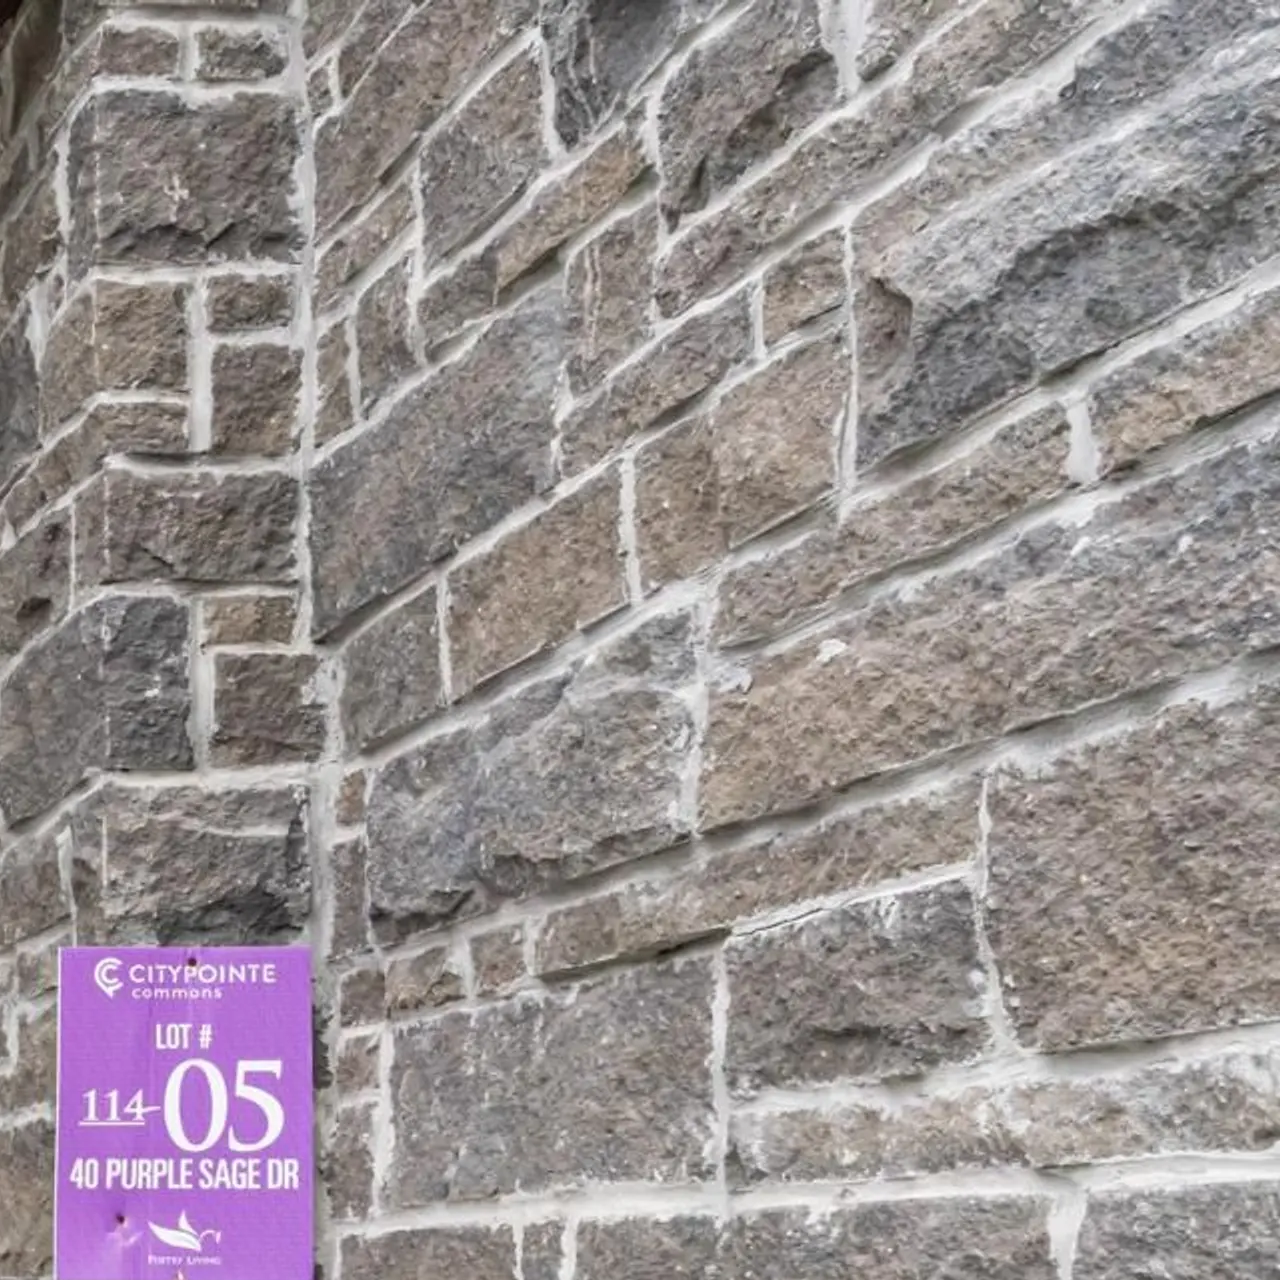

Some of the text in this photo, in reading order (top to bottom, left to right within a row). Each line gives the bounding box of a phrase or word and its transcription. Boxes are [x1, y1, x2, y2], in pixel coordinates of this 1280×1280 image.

[128, 963, 277, 984] CITYPOINTE
[131, 986, 223, 1000] commons
[155, 1023, 213, 1050] LOT #
[70, 1157, 299, 1190] 40 PURPLE SAGE DR
